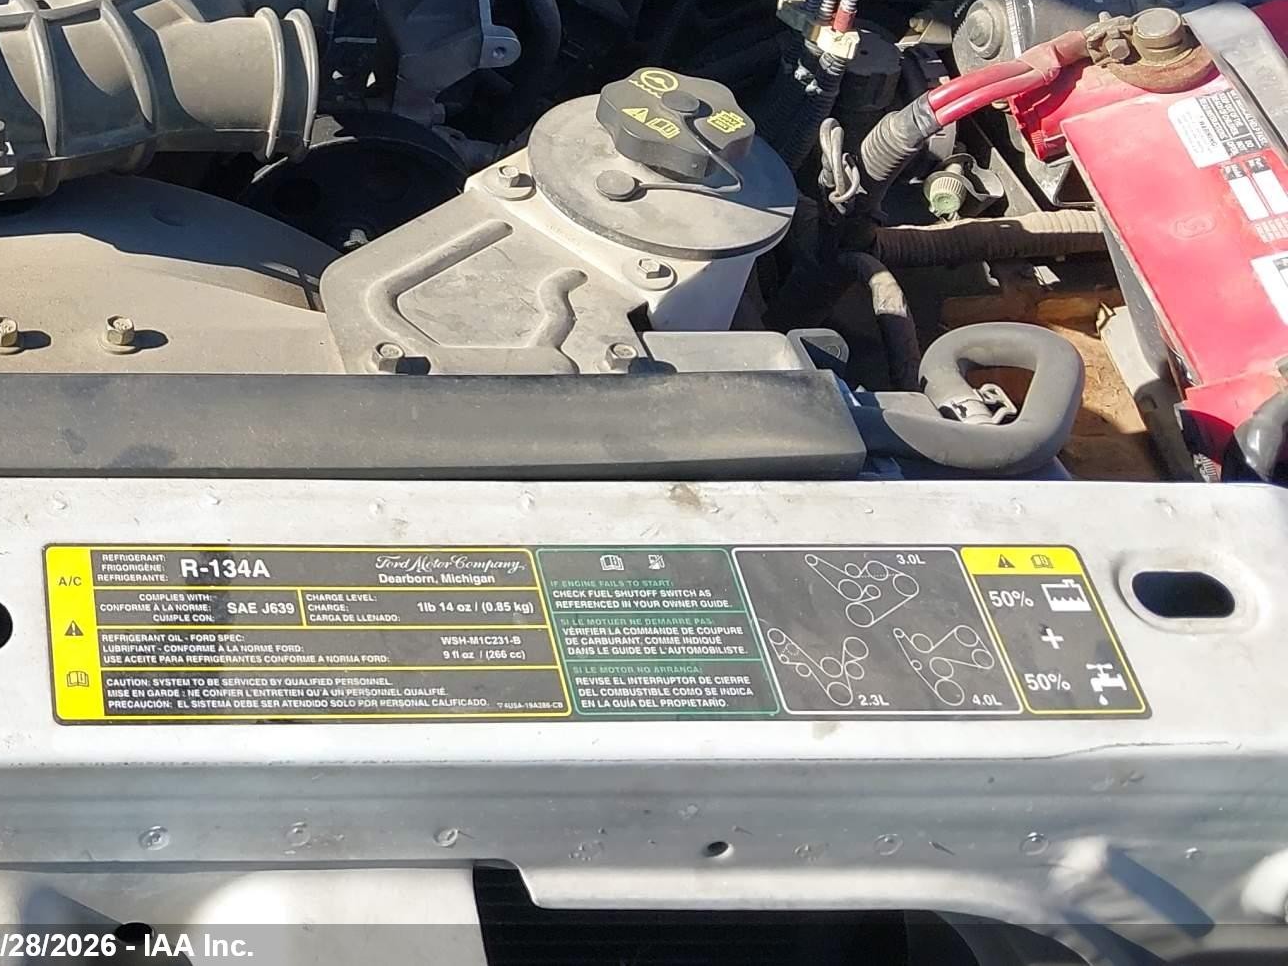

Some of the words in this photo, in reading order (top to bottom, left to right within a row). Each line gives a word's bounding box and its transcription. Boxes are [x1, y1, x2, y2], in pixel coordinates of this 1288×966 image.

[896, 554, 926, 565] 3.0L
[181, 559, 270, 578] R-134A
[59, 577, 82, 586] A/C
[441, 574, 495, 585] Michigan
[346, 594, 377, 602] LEVEL:
[988, 591, 1034, 607] 50%
[227, 603, 258, 614] SAE
[262, 603, 294, 614] J639
[417, 603, 435, 612] 1lb
[439, 603, 453, 612] 14
[482, 602, 511, 612] (0.85
[514, 602, 534, 613] kg)
[153, 614, 190, 622] CUMPLE
[608, 627, 621, 635] LA
[623, 627, 679, 635] COMMANDE
[441, 637, 521, 645] WSH-M1C231-B
[565, 637, 578, 645] DE
[104, 655, 122, 663] USE
[125, 655, 157, 663] ACEITE
[160, 655, 184, 663] PARA
[186, 655, 262, 663] REFRIGERANTES
[264, 655, 315, 663] CONFORME
[326, 655, 360, 663] NORMA
[362, 655, 391, 663] FORD:
[222, 678, 267, 686] SERVICED
[1024, 673, 1071, 691] 50%
[178, 700, 189, 708] EL
[192, 700, 231, 708] SISTEMA
[234, 700, 258, 708] DEBE
[380, 699, 429, 707] PERSONAL
[859, 694, 889, 706] 2.3L
[972, 694, 1002, 706] 4.0L
